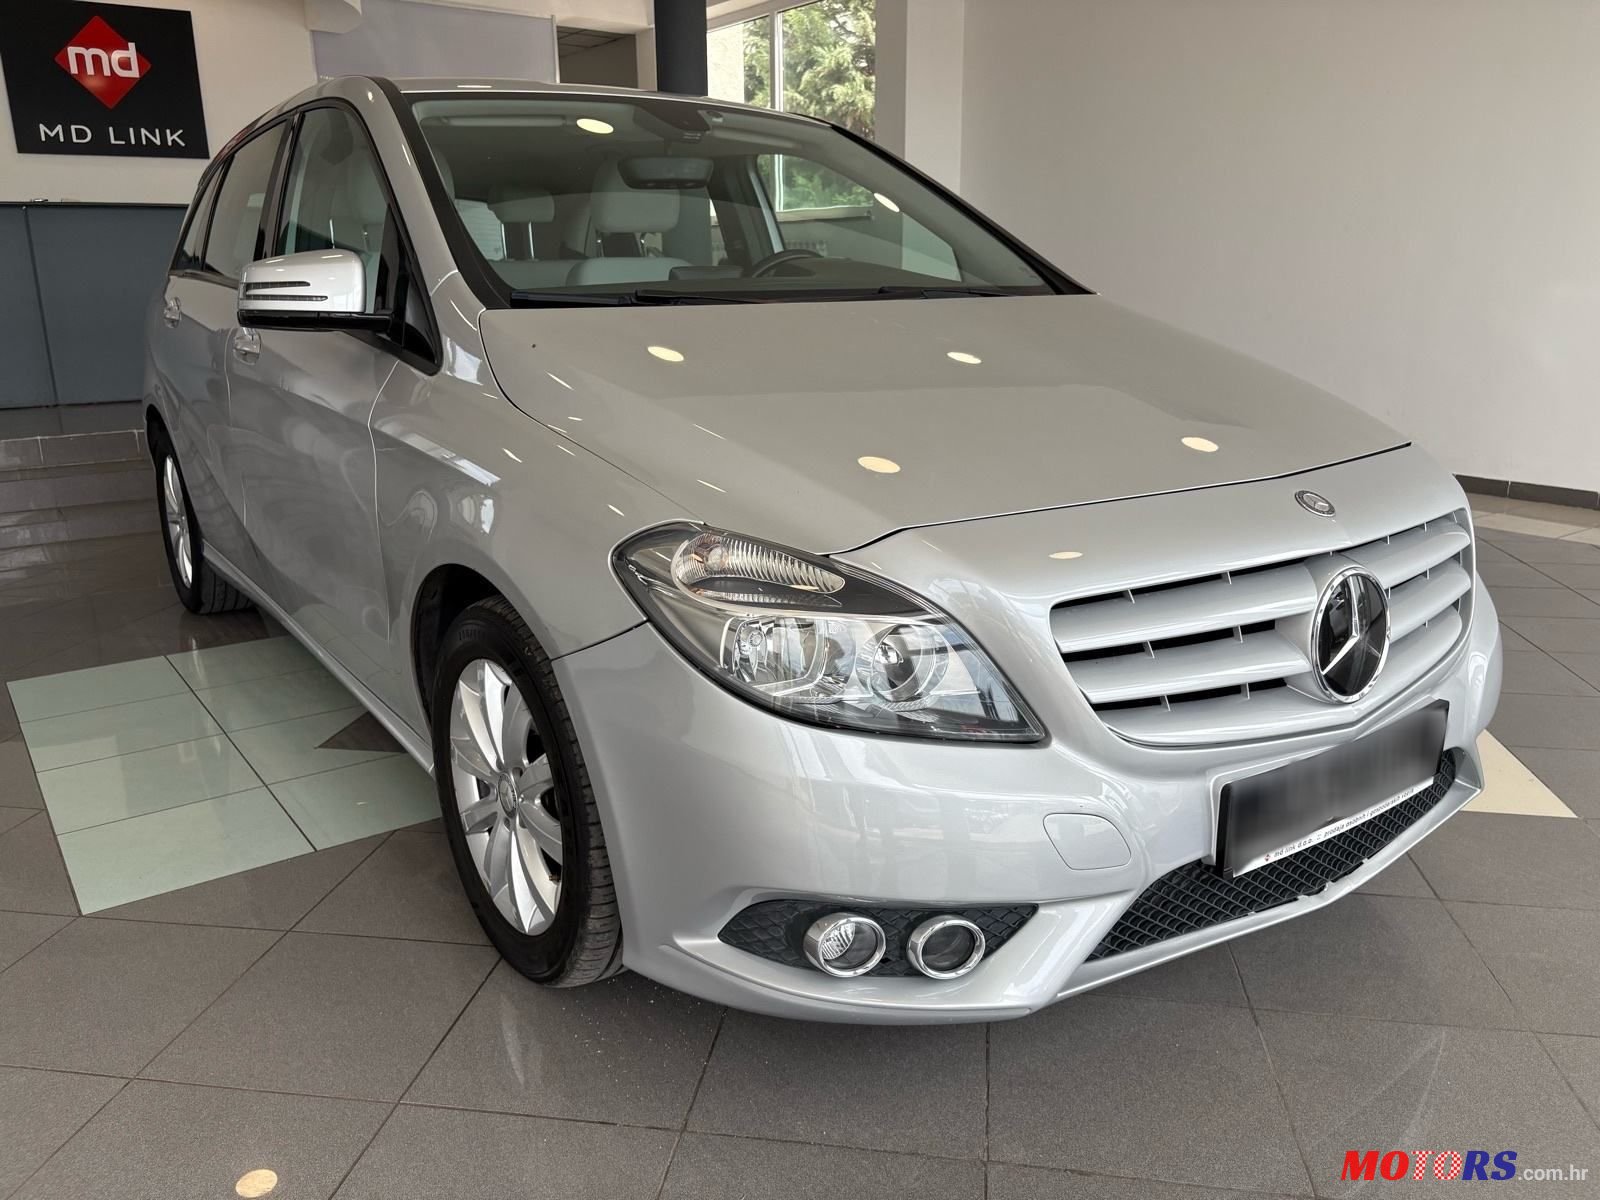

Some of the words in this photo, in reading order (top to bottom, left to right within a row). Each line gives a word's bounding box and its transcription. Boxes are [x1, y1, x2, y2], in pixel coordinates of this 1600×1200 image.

[67, 42, 140, 78] md
[39, 123, 92, 143] MD
[109, 127, 186, 147] LINK
